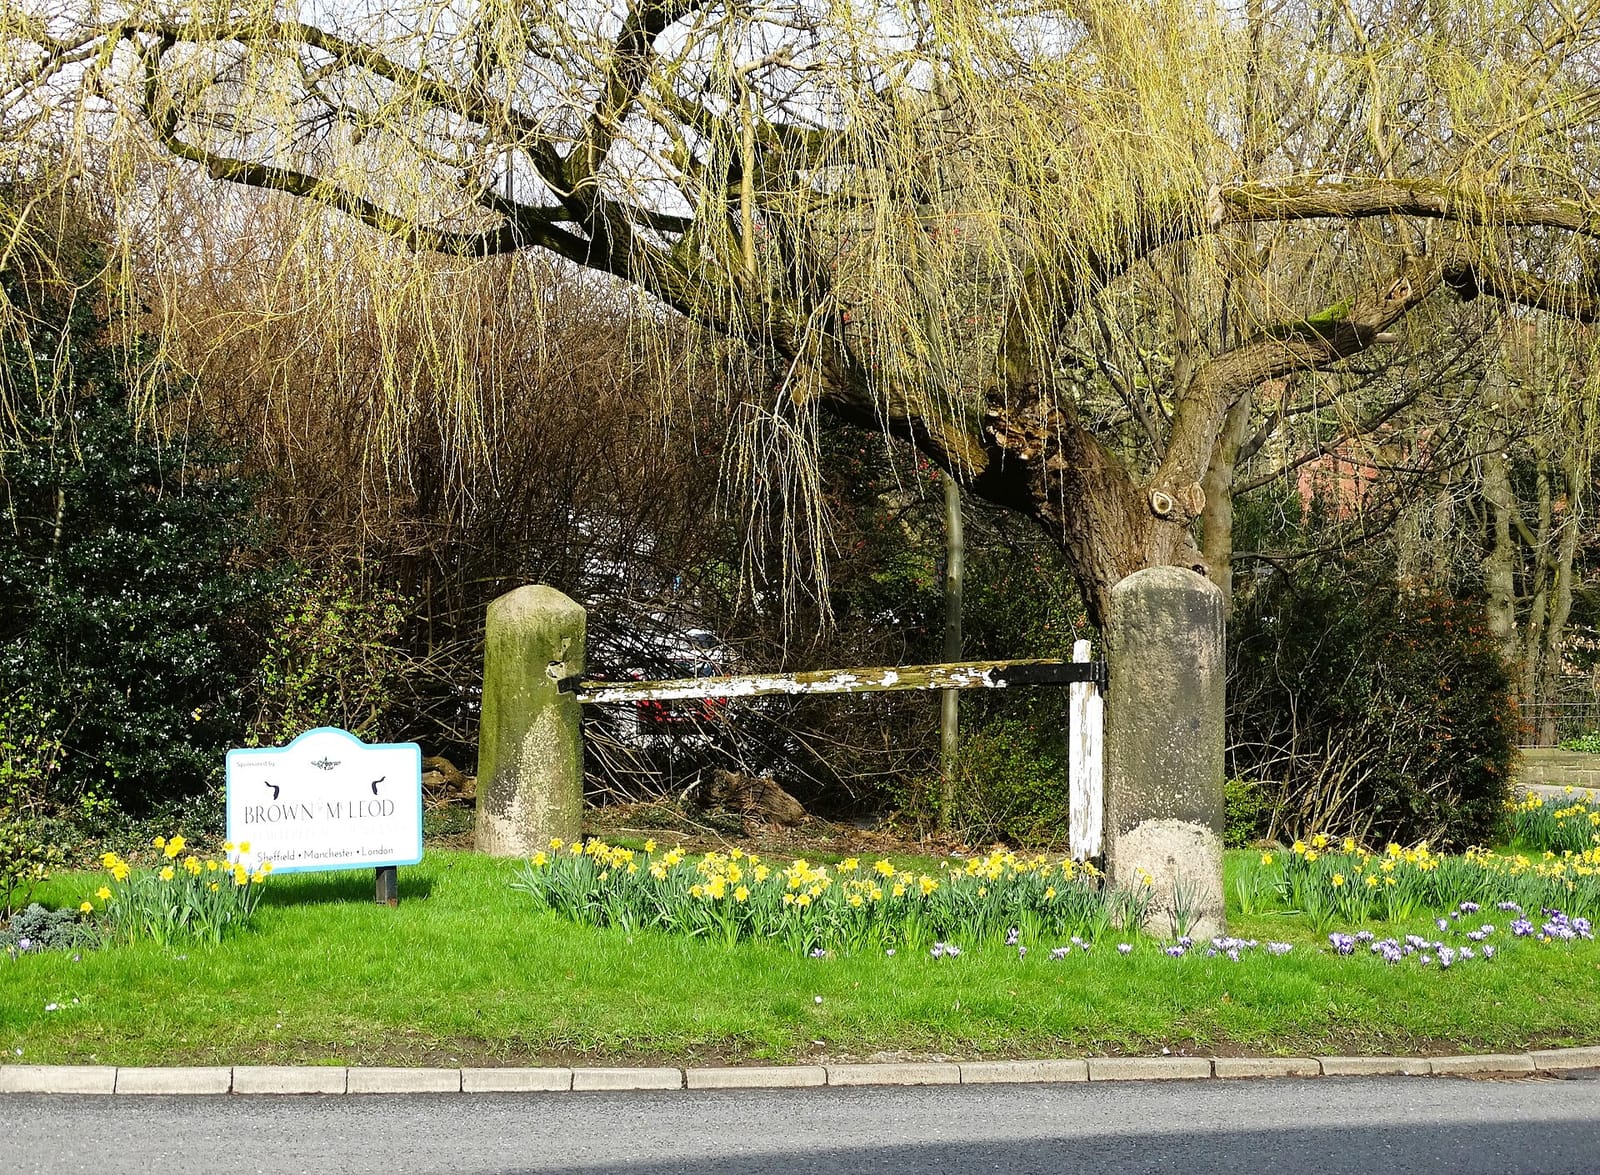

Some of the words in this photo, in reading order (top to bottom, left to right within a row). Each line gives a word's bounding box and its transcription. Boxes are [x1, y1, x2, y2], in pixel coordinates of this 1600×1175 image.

[244, 802, 314, 824] BROWN
[257, 850, 295, 863] Sheffield
[303, 848, 353, 860] Manchester
[361, 844, 394, 856] London
